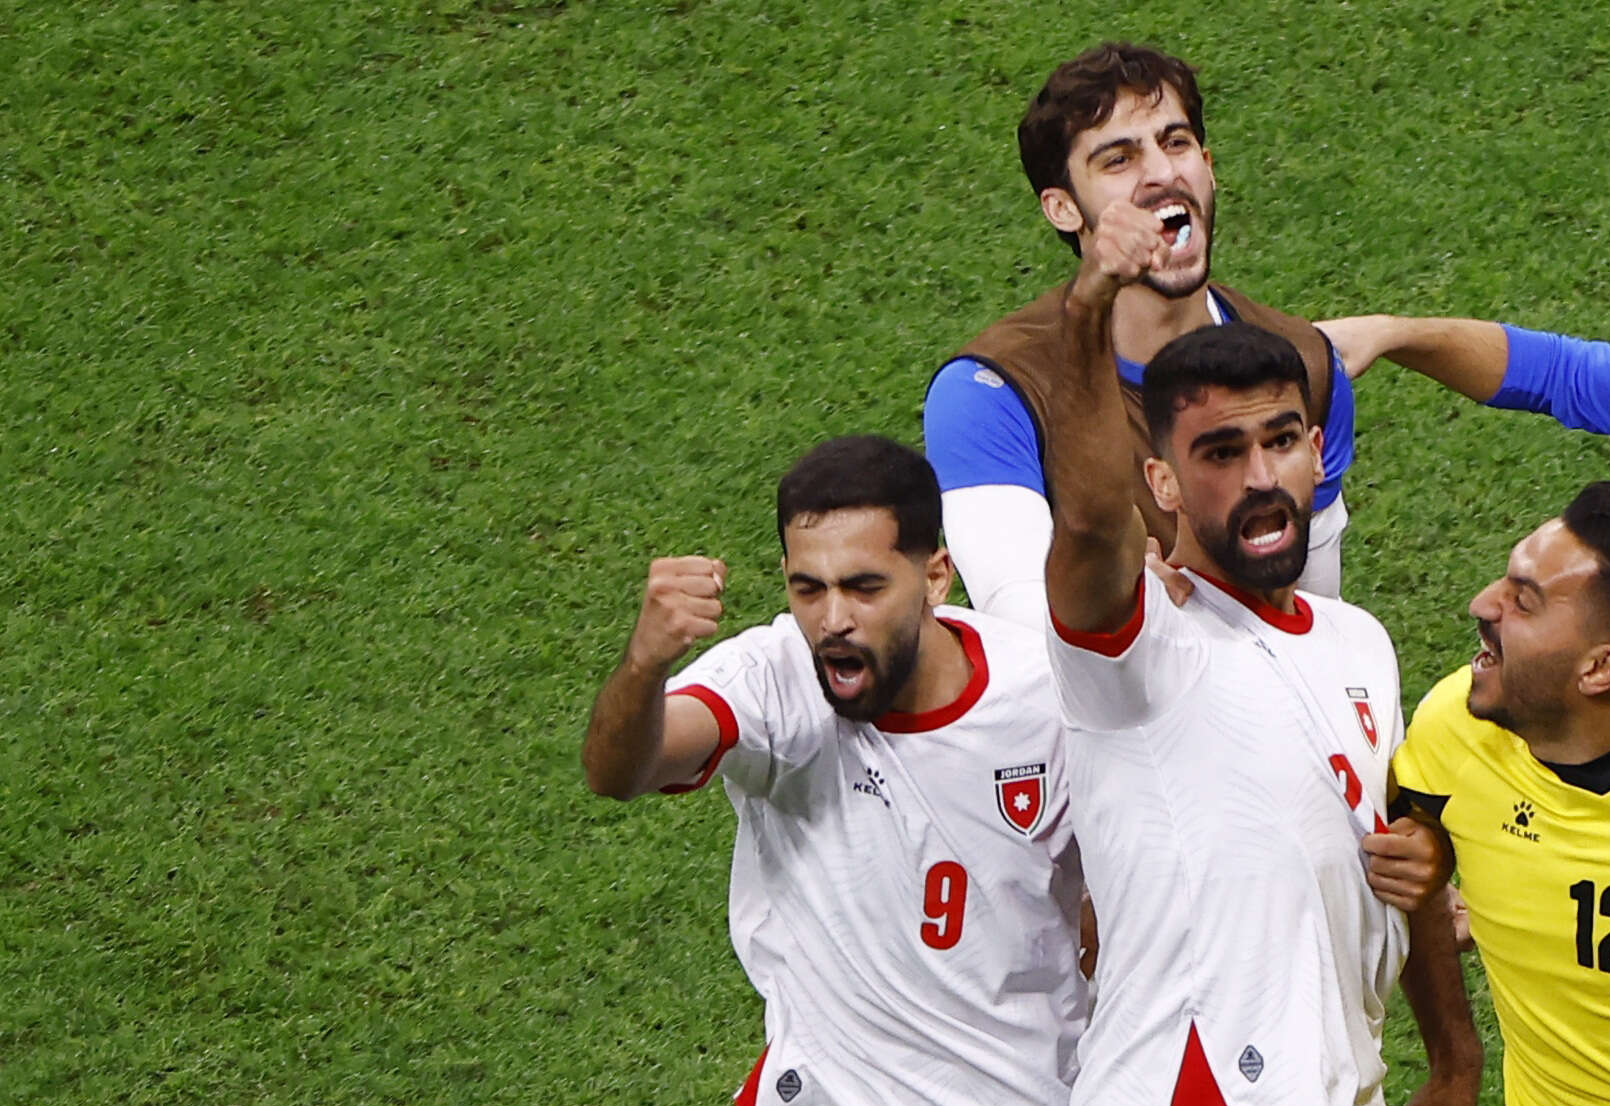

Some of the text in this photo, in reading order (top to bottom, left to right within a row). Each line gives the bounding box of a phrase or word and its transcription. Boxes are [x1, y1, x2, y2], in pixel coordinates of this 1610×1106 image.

[1000, 765, 1041, 779] JORDAN
[1501, 823, 1541, 843] KELME
[920, 861, 968, 951] 9
